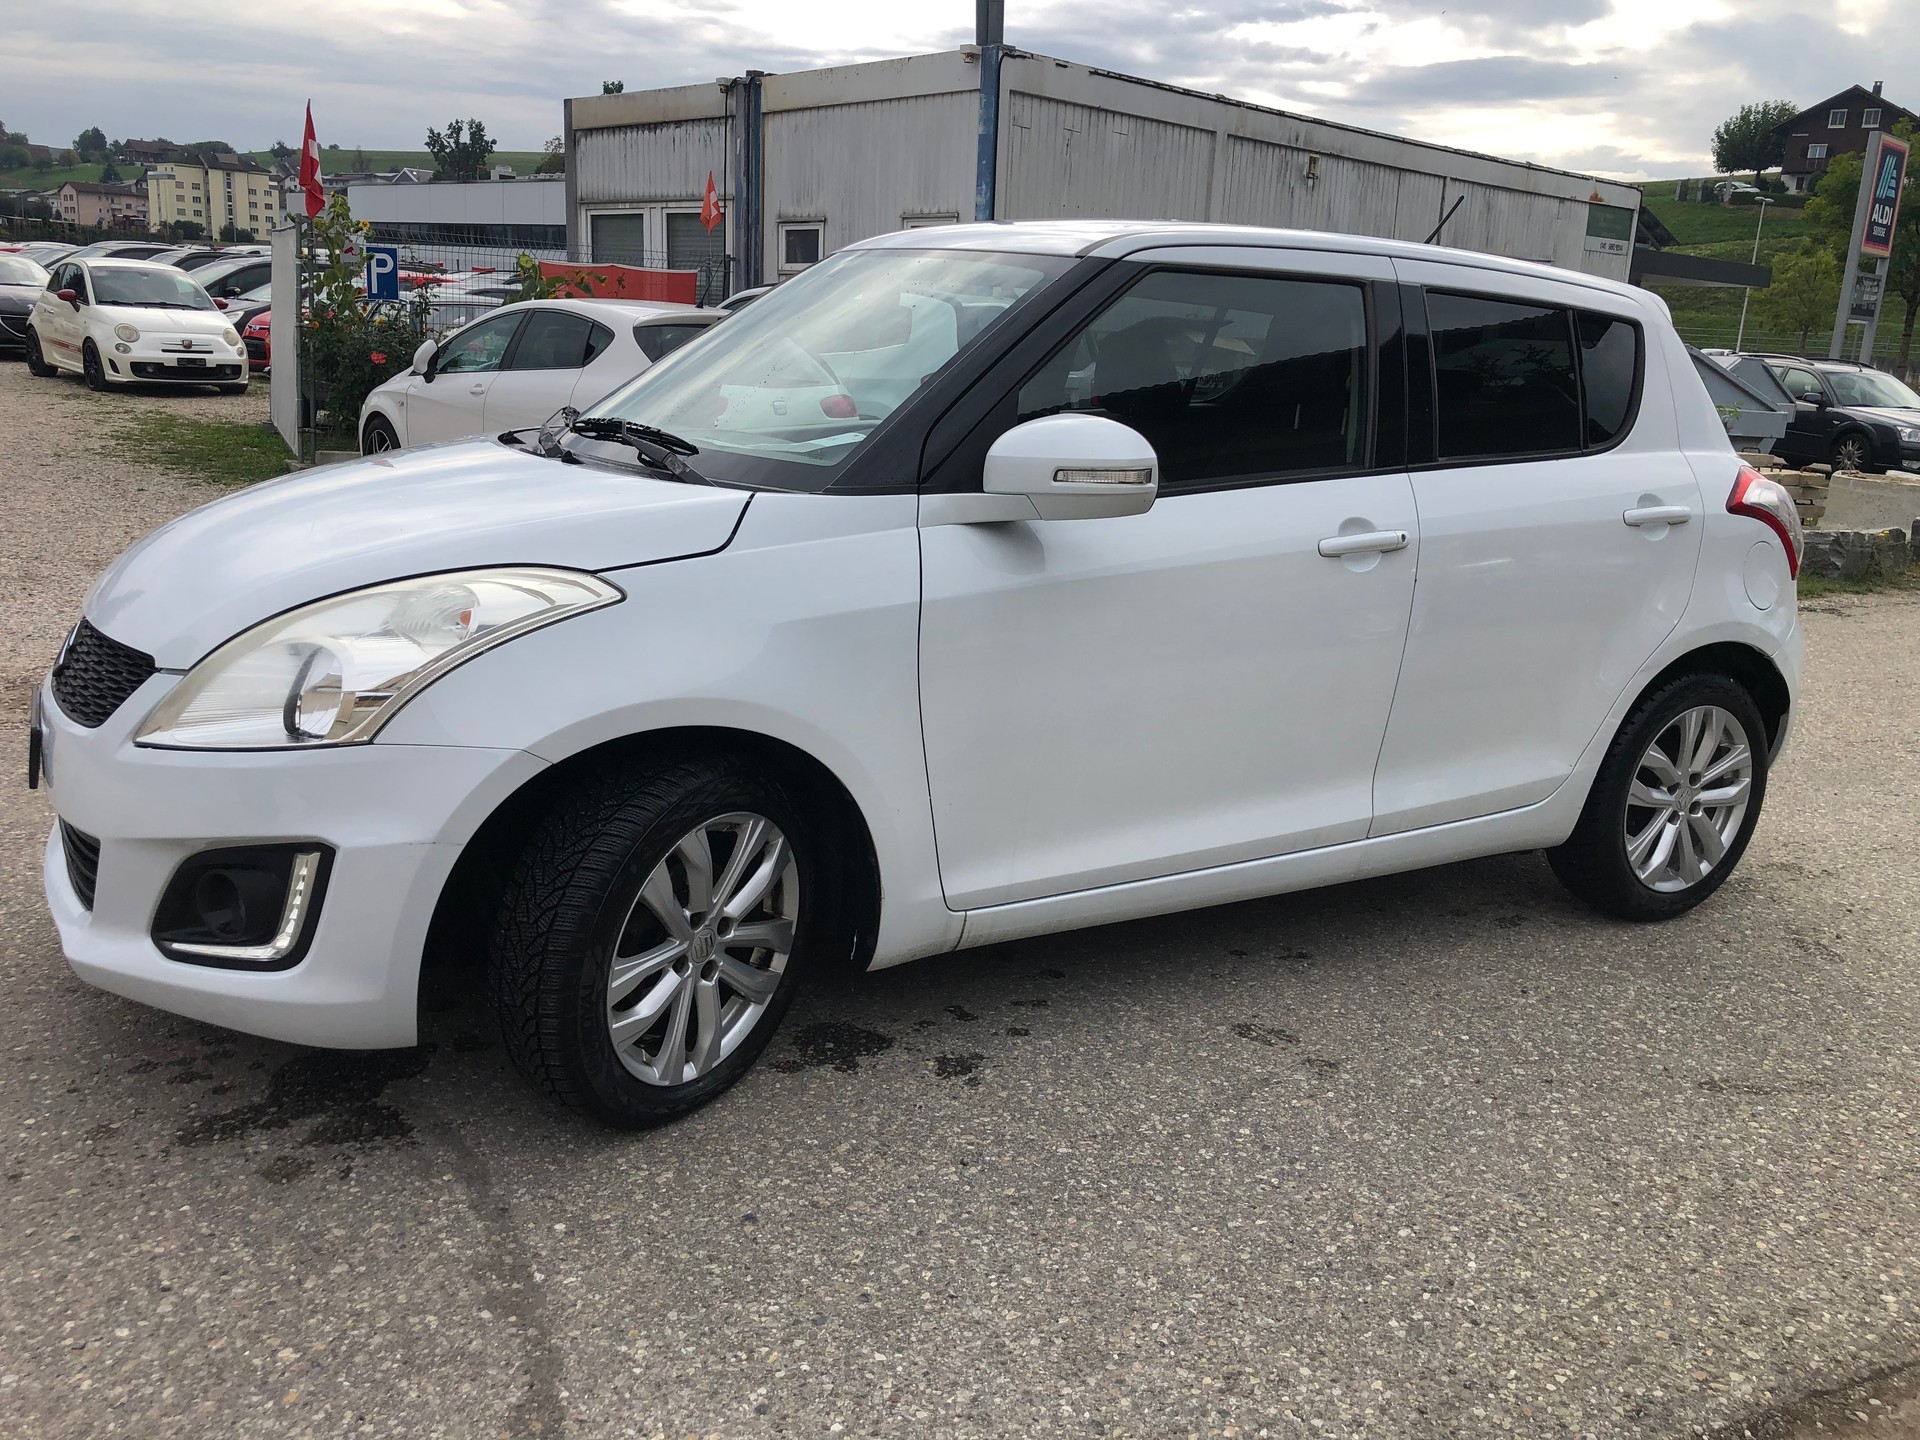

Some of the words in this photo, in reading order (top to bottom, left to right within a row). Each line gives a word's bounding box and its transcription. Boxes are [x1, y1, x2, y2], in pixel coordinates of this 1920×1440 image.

[1871, 203, 1894, 226] ALDI
[1872, 226, 1887, 238] SUISSE
[370, 252, 394, 294] P
